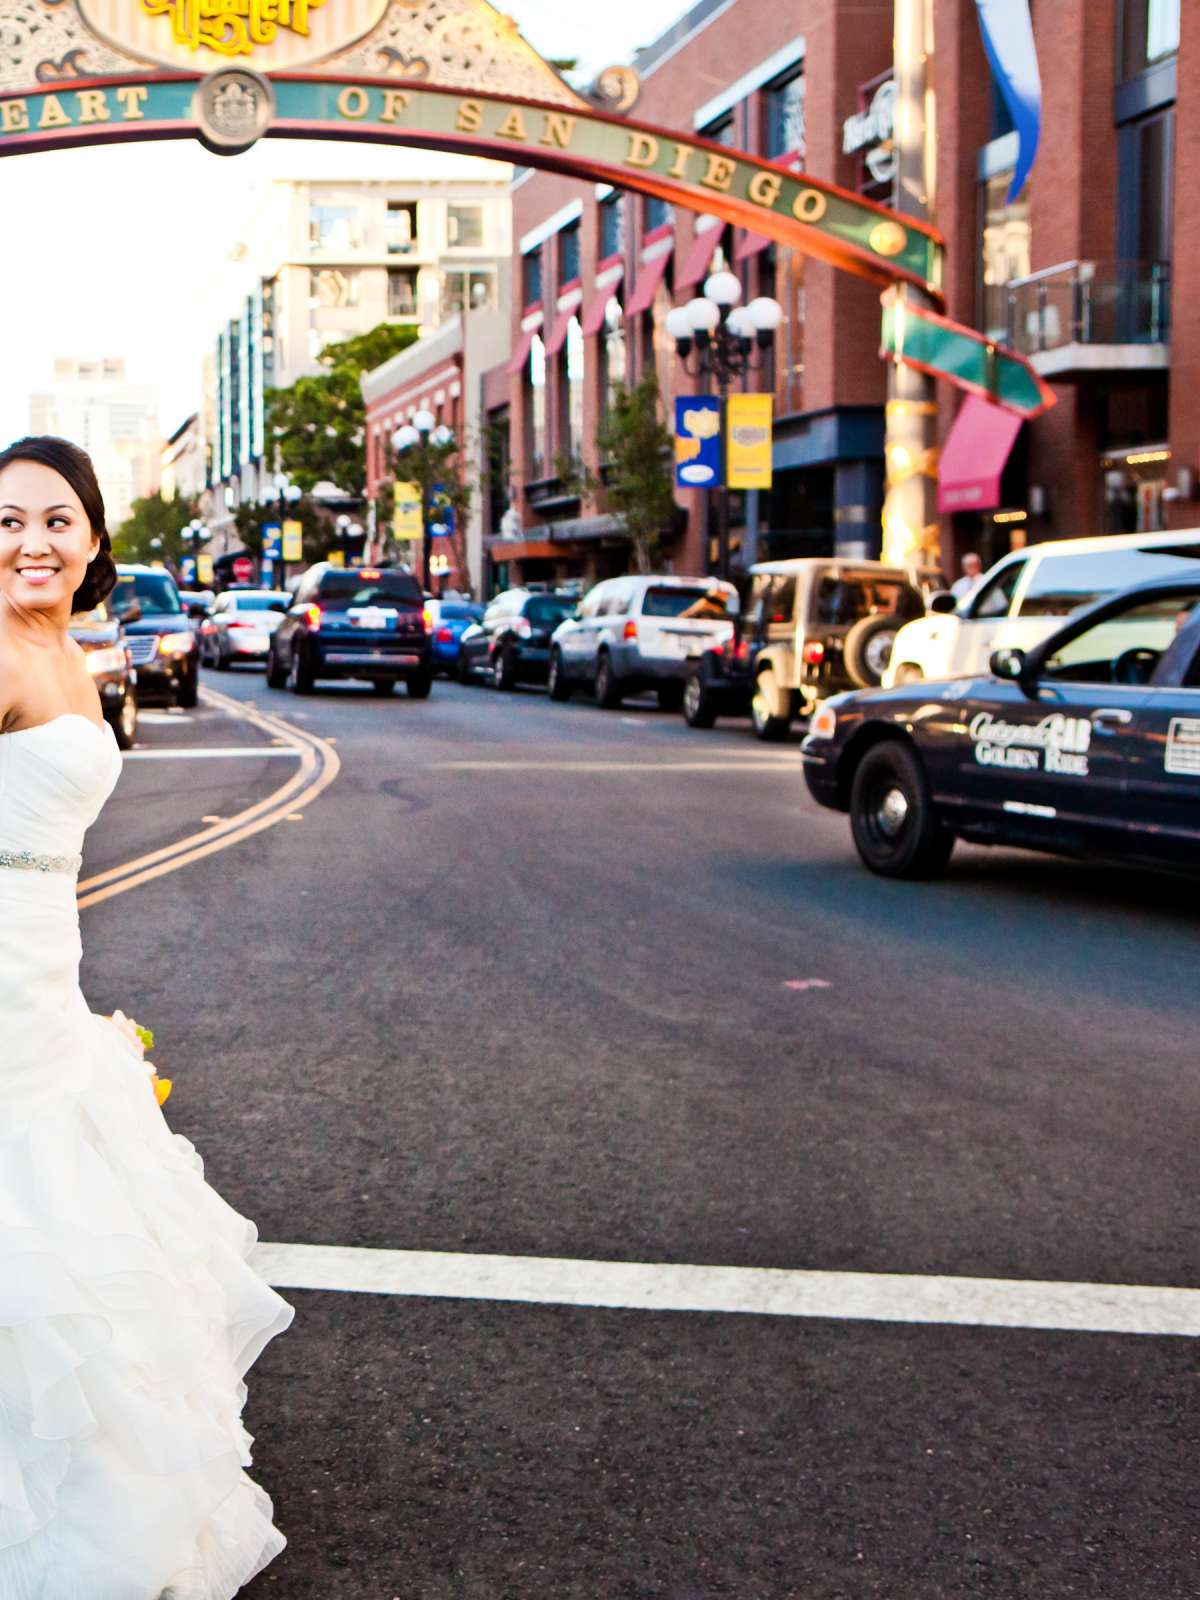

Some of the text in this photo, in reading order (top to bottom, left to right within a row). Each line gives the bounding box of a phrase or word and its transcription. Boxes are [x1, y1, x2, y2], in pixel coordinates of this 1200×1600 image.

[337, 86, 409, 122] OF
[456, 100, 579, 150] SAN
[625, 132, 829, 224] DIEGO
